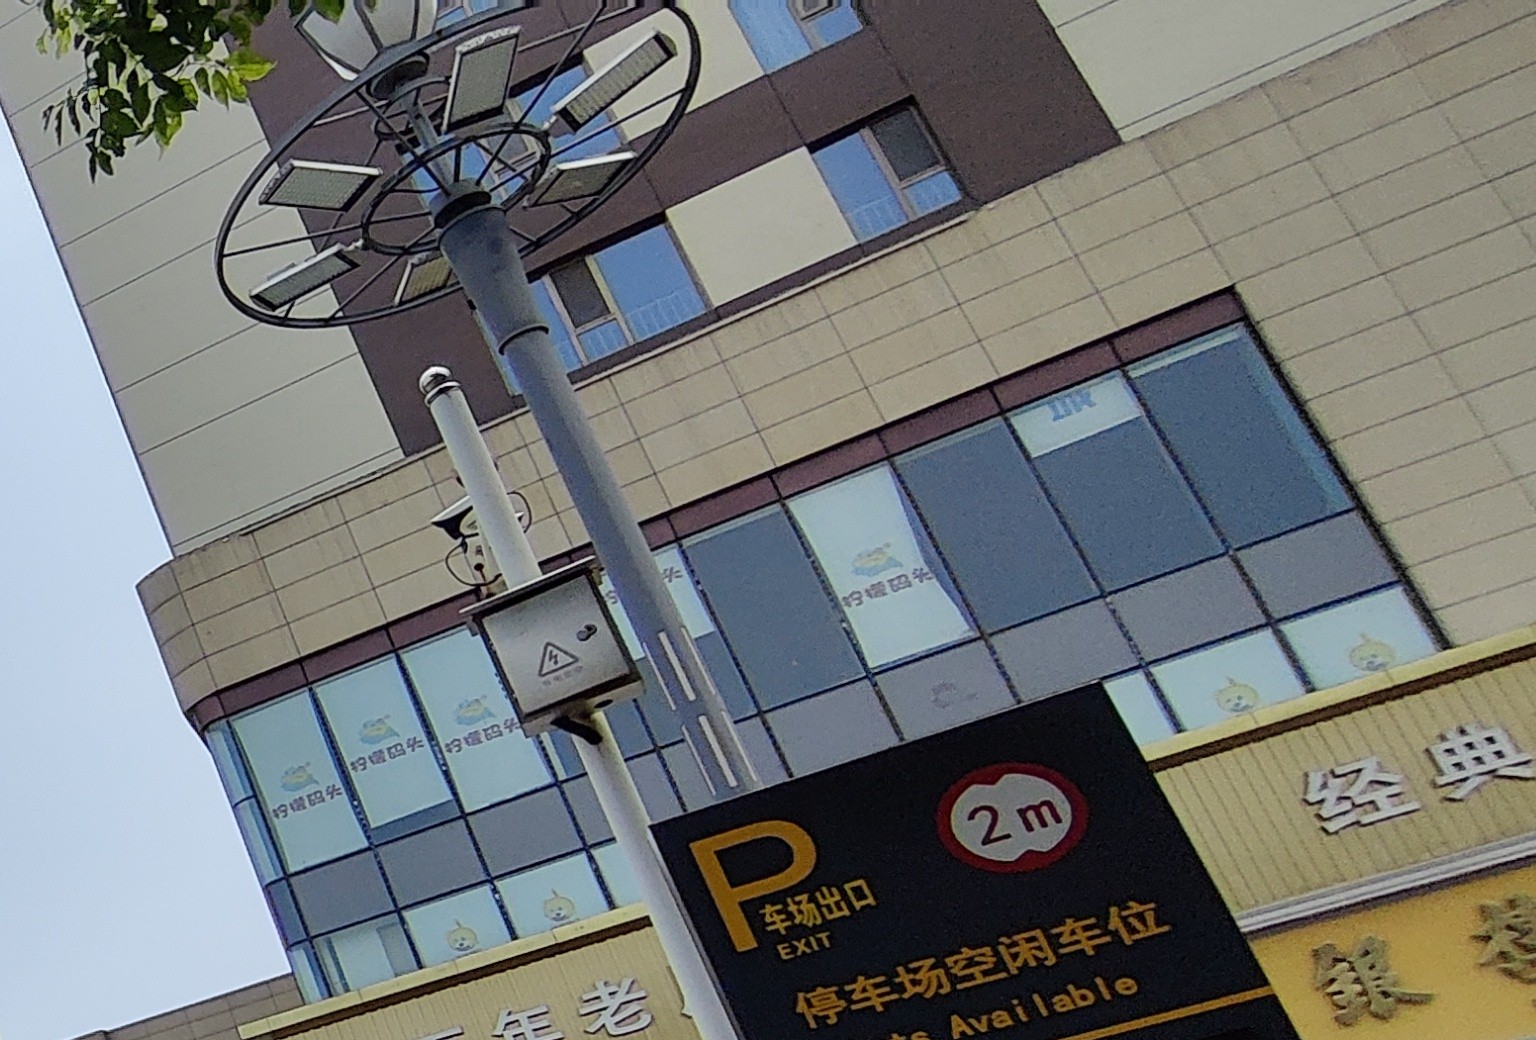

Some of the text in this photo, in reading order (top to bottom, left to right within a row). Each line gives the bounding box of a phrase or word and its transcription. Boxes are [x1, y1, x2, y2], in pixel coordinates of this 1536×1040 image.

[1301, 723, 1536, 835] 经典
[689, 819, 818, 952] P
[759, 879, 876, 936] 车场出口
[777, 931, 832, 960] EXIT
[794, 900, 1173, 1030] 停车场空闲车位
[950, 976, 1139, 1040] Available
